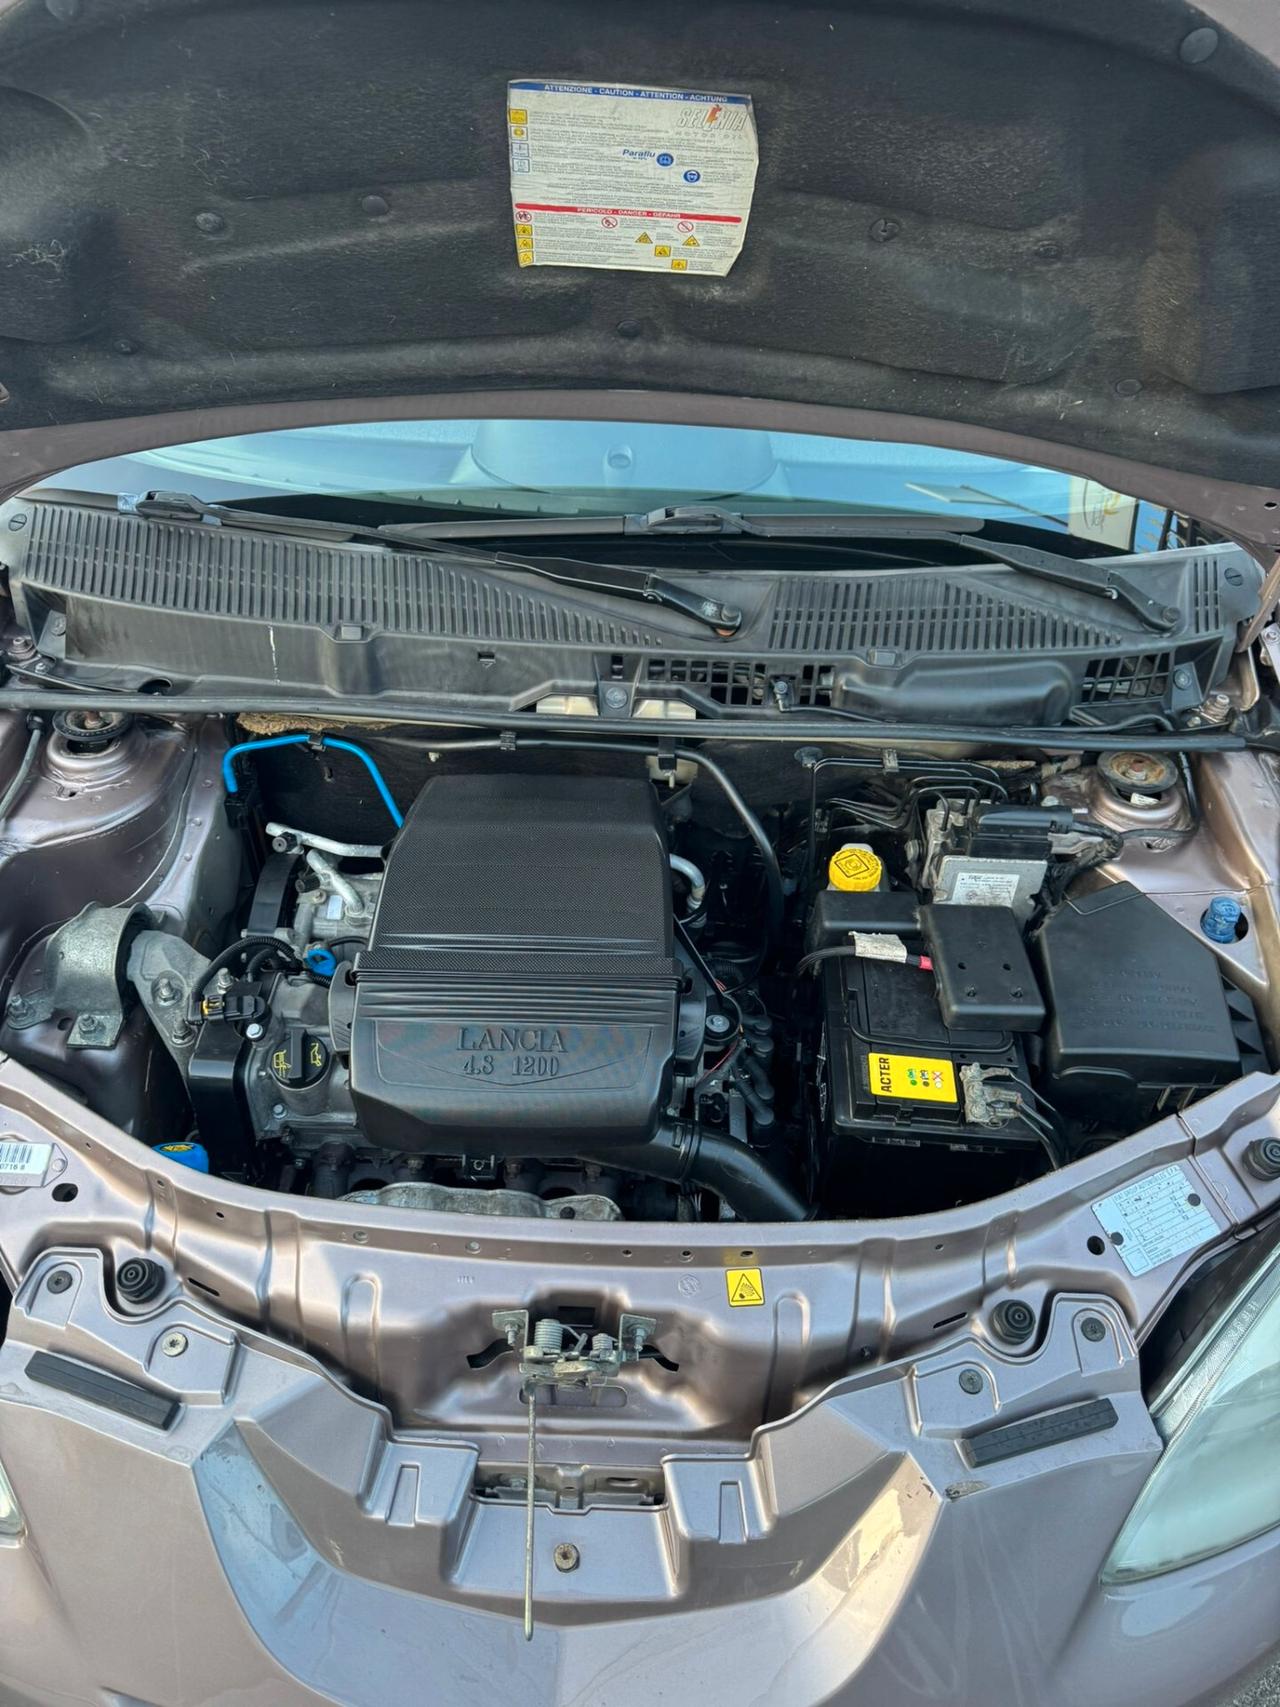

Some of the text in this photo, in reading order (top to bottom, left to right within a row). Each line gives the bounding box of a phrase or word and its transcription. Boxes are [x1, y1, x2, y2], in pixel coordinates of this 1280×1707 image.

[544, 84, 728, 103] ATTENZIONE CAUTION ATTENTION ACHTUNG
[676, 104, 748, 131] SELENIA
[622, 148, 656, 158] Paraflu
[577, 207, 613, 215] PERICOLO
[457, 1026, 568, 1053] LANCIA
[511, 1055, 560, 1076] 1200
[879, 1057, 892, 1093] ACTER
